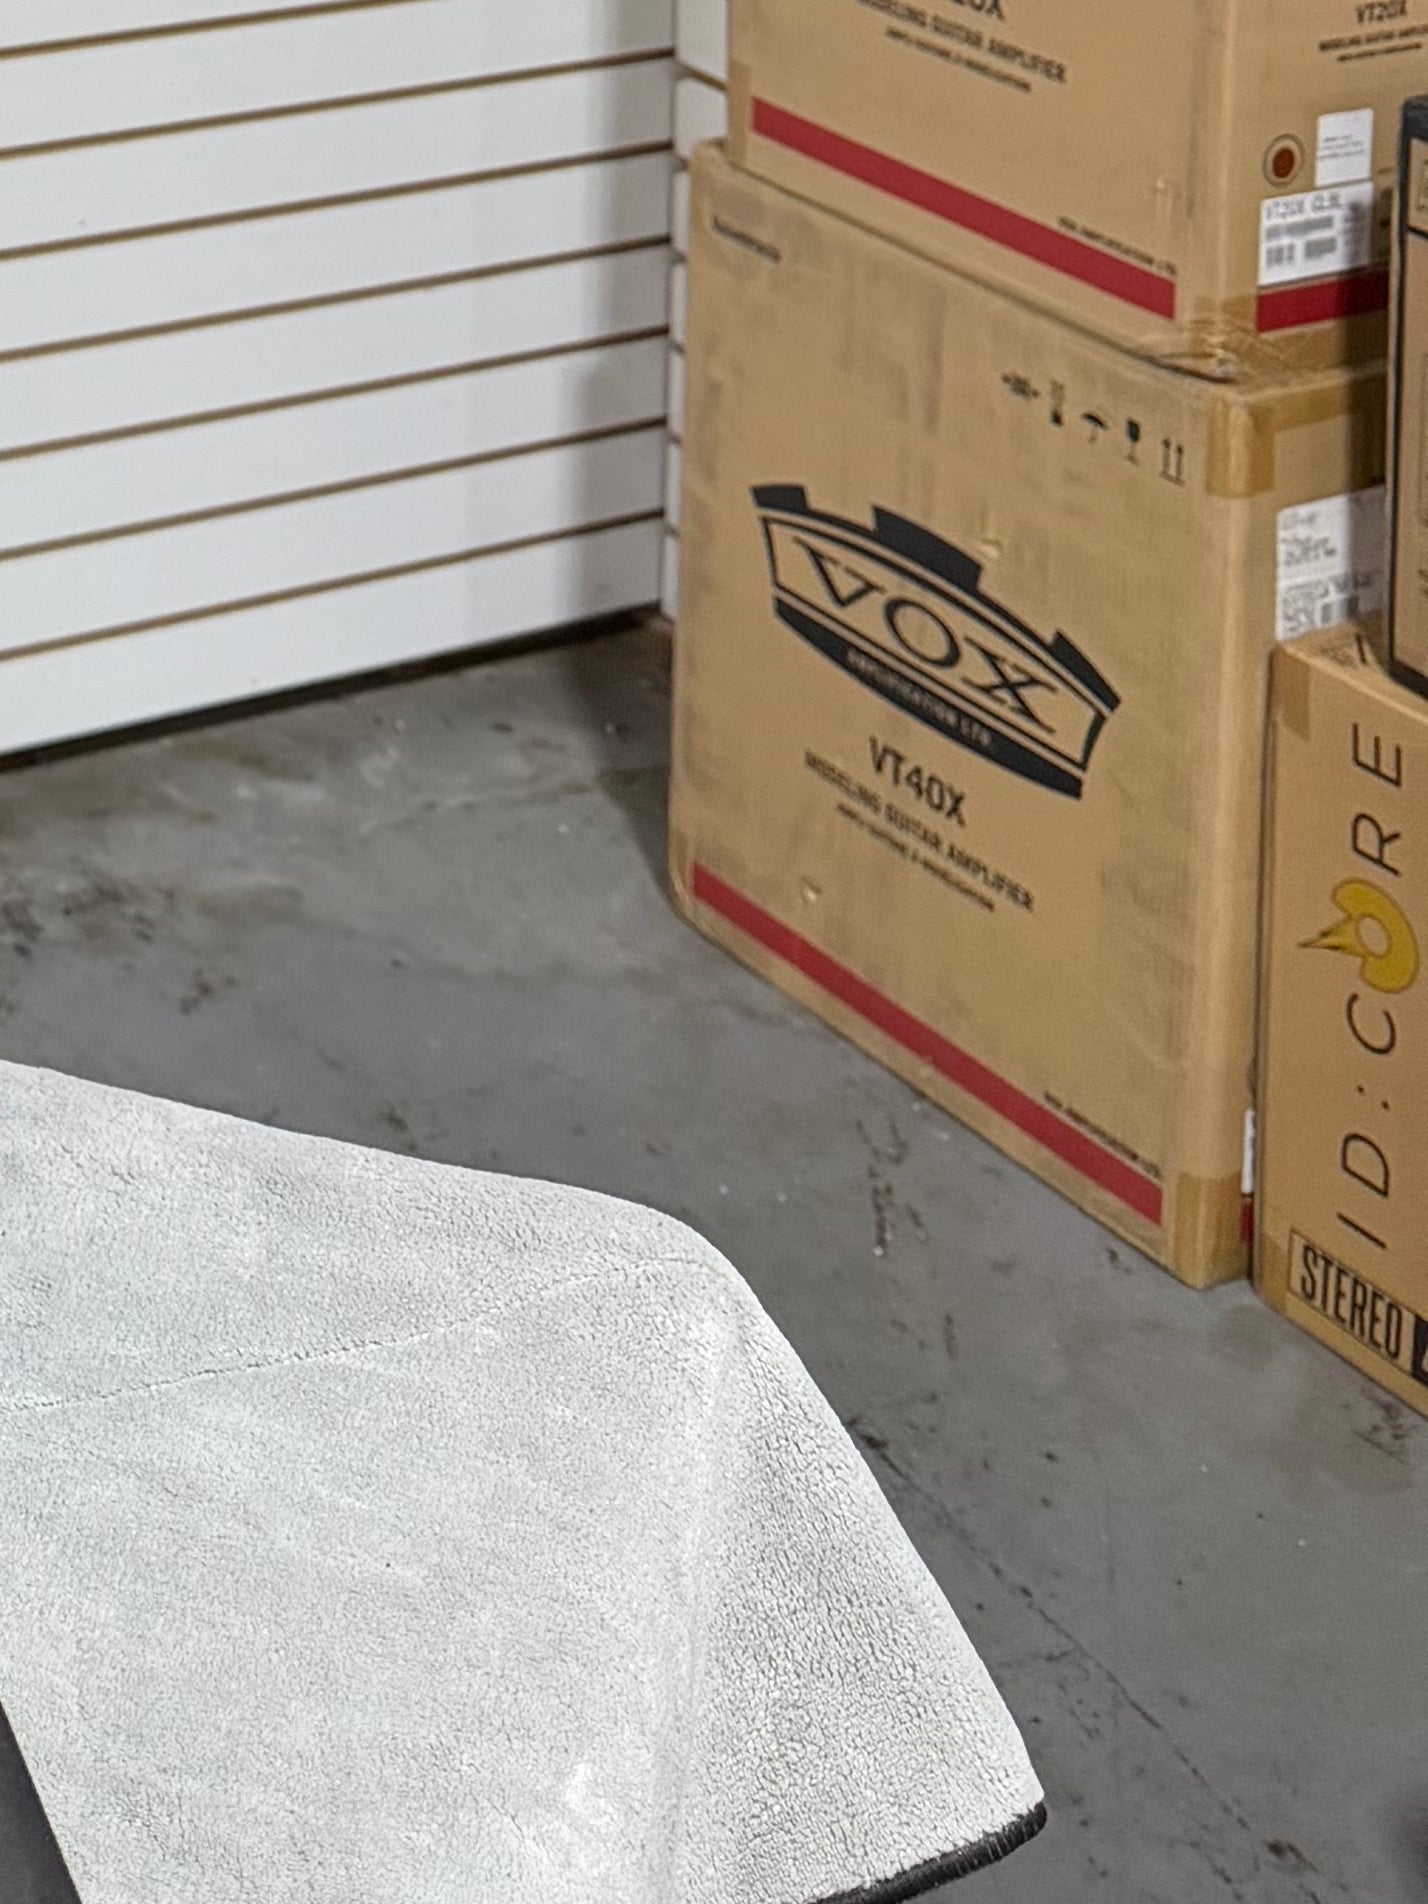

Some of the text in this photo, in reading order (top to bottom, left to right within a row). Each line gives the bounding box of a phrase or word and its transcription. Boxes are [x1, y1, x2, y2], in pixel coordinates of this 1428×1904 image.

[988, 36, 1068, 85] AMPLIFIER
[792, 534, 1059, 736] VOX
[867, 734, 967, 829] VT40X
[946, 837, 1036, 913] AMPLIFIER
[1300, 1243, 1403, 1360] STEREO
